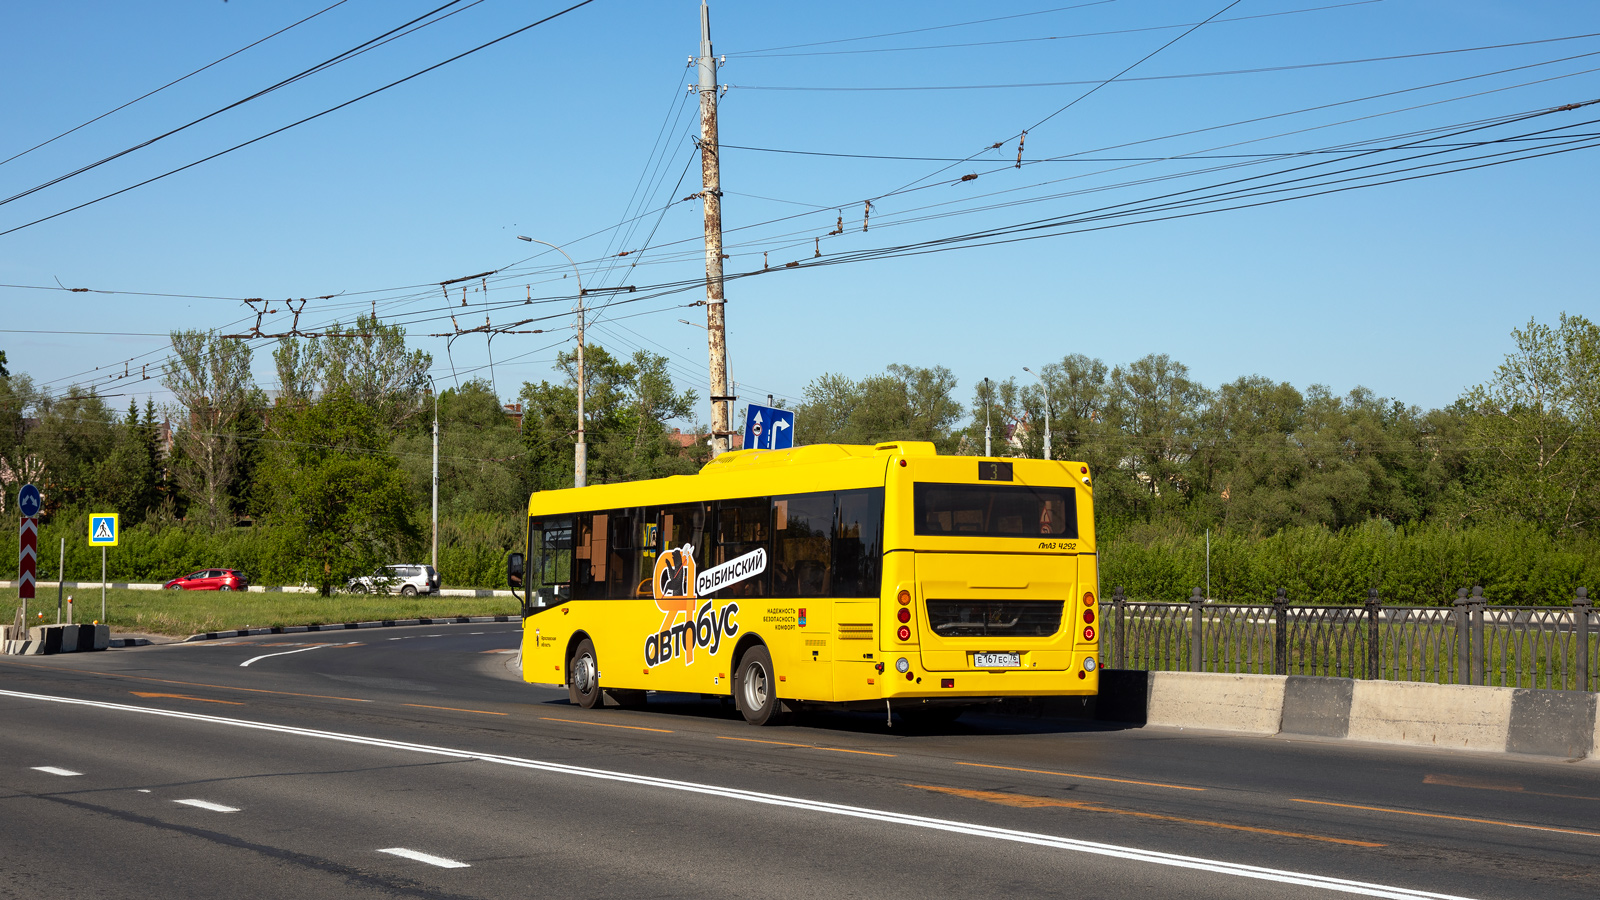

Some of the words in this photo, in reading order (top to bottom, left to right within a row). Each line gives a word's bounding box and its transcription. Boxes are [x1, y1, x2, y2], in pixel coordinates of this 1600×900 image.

[990, 463, 997, 480] 3
[1058, 542, 1077, 550] 4292
[699, 550, 762, 592] РЫБИНСКИЙ
[645, 600, 739, 666] автобус
